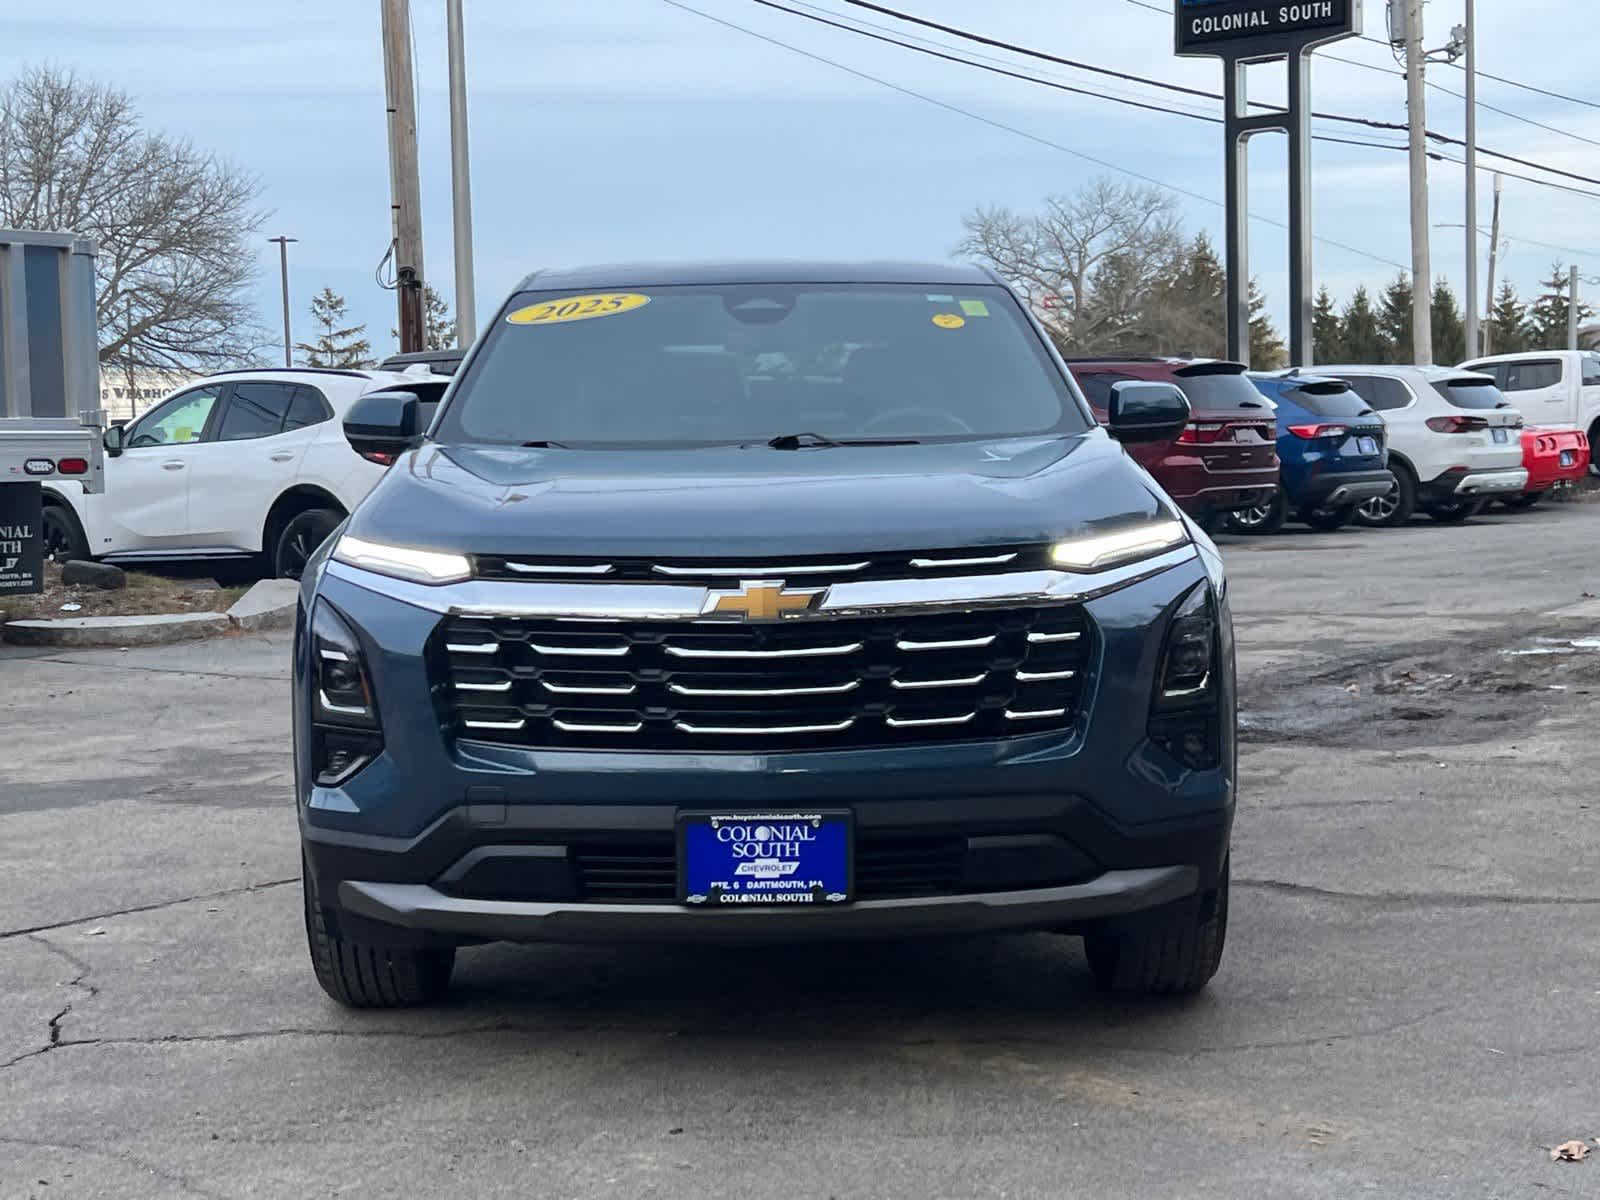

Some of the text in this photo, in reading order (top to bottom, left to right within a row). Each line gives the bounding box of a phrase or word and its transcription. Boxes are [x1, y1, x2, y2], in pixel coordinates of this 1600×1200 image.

[1192, 1, 1332, 34] COLONIAL SOUTH
[530, 295, 630, 321] 2025
[717, 825, 816, 842] COLONIAL
[732, 842, 800, 858] SOUTH
[741, 864, 793, 873] CHEVROLET
[733, 881, 740, 889] 6
[747, 880, 807, 890] DARTMOUTH,
[720, 893, 813, 903] COLONIAL SOUTH
